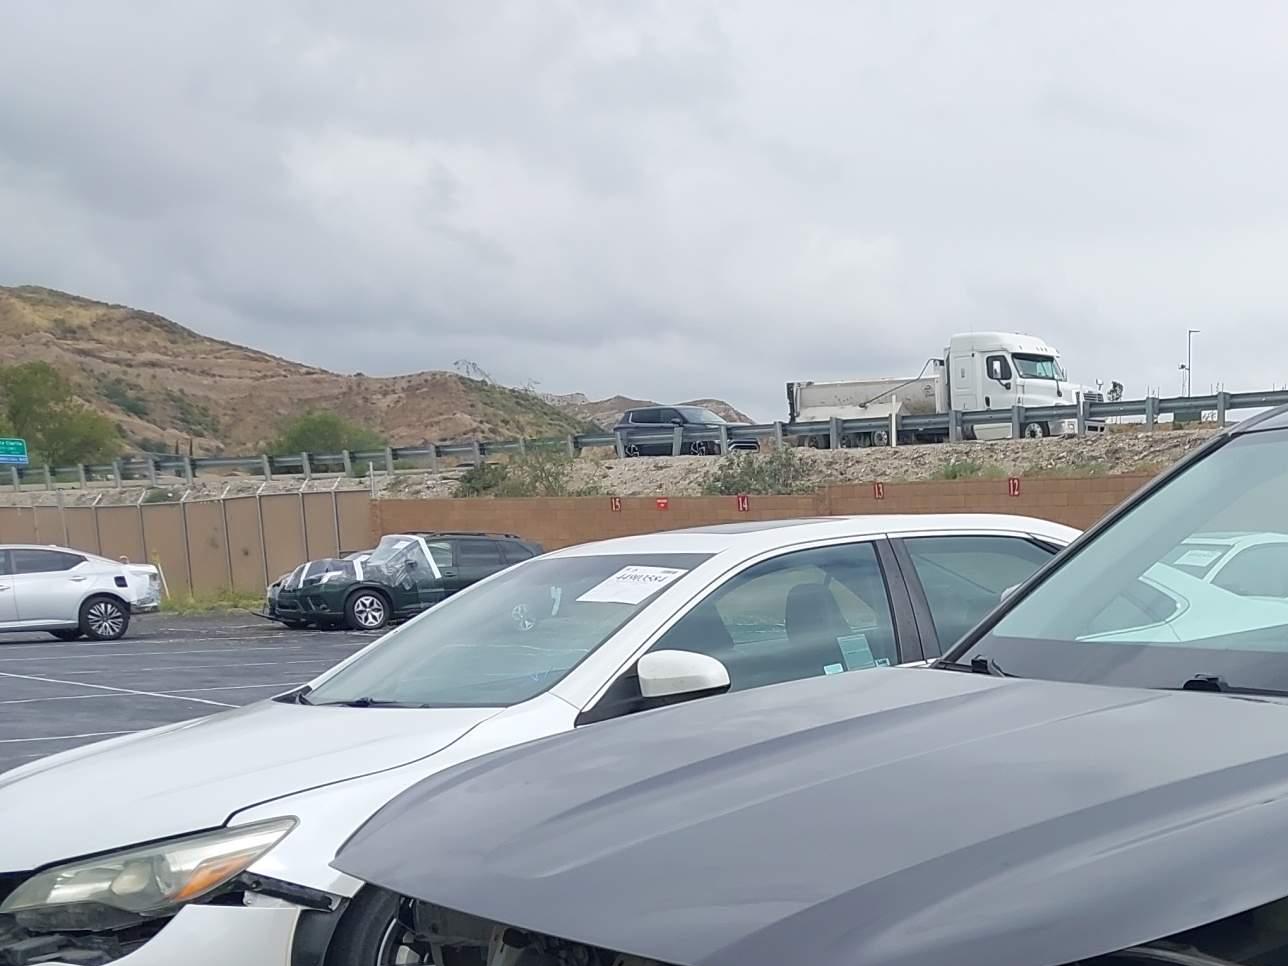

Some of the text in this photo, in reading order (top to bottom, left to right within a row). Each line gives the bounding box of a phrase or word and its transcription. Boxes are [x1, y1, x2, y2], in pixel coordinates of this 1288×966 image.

[874, 483, 884, 500] 13
[1010, 479, 1020, 496] 12
[611, 497, 621, 512] 15
[738, 496, 749, 512] 14
